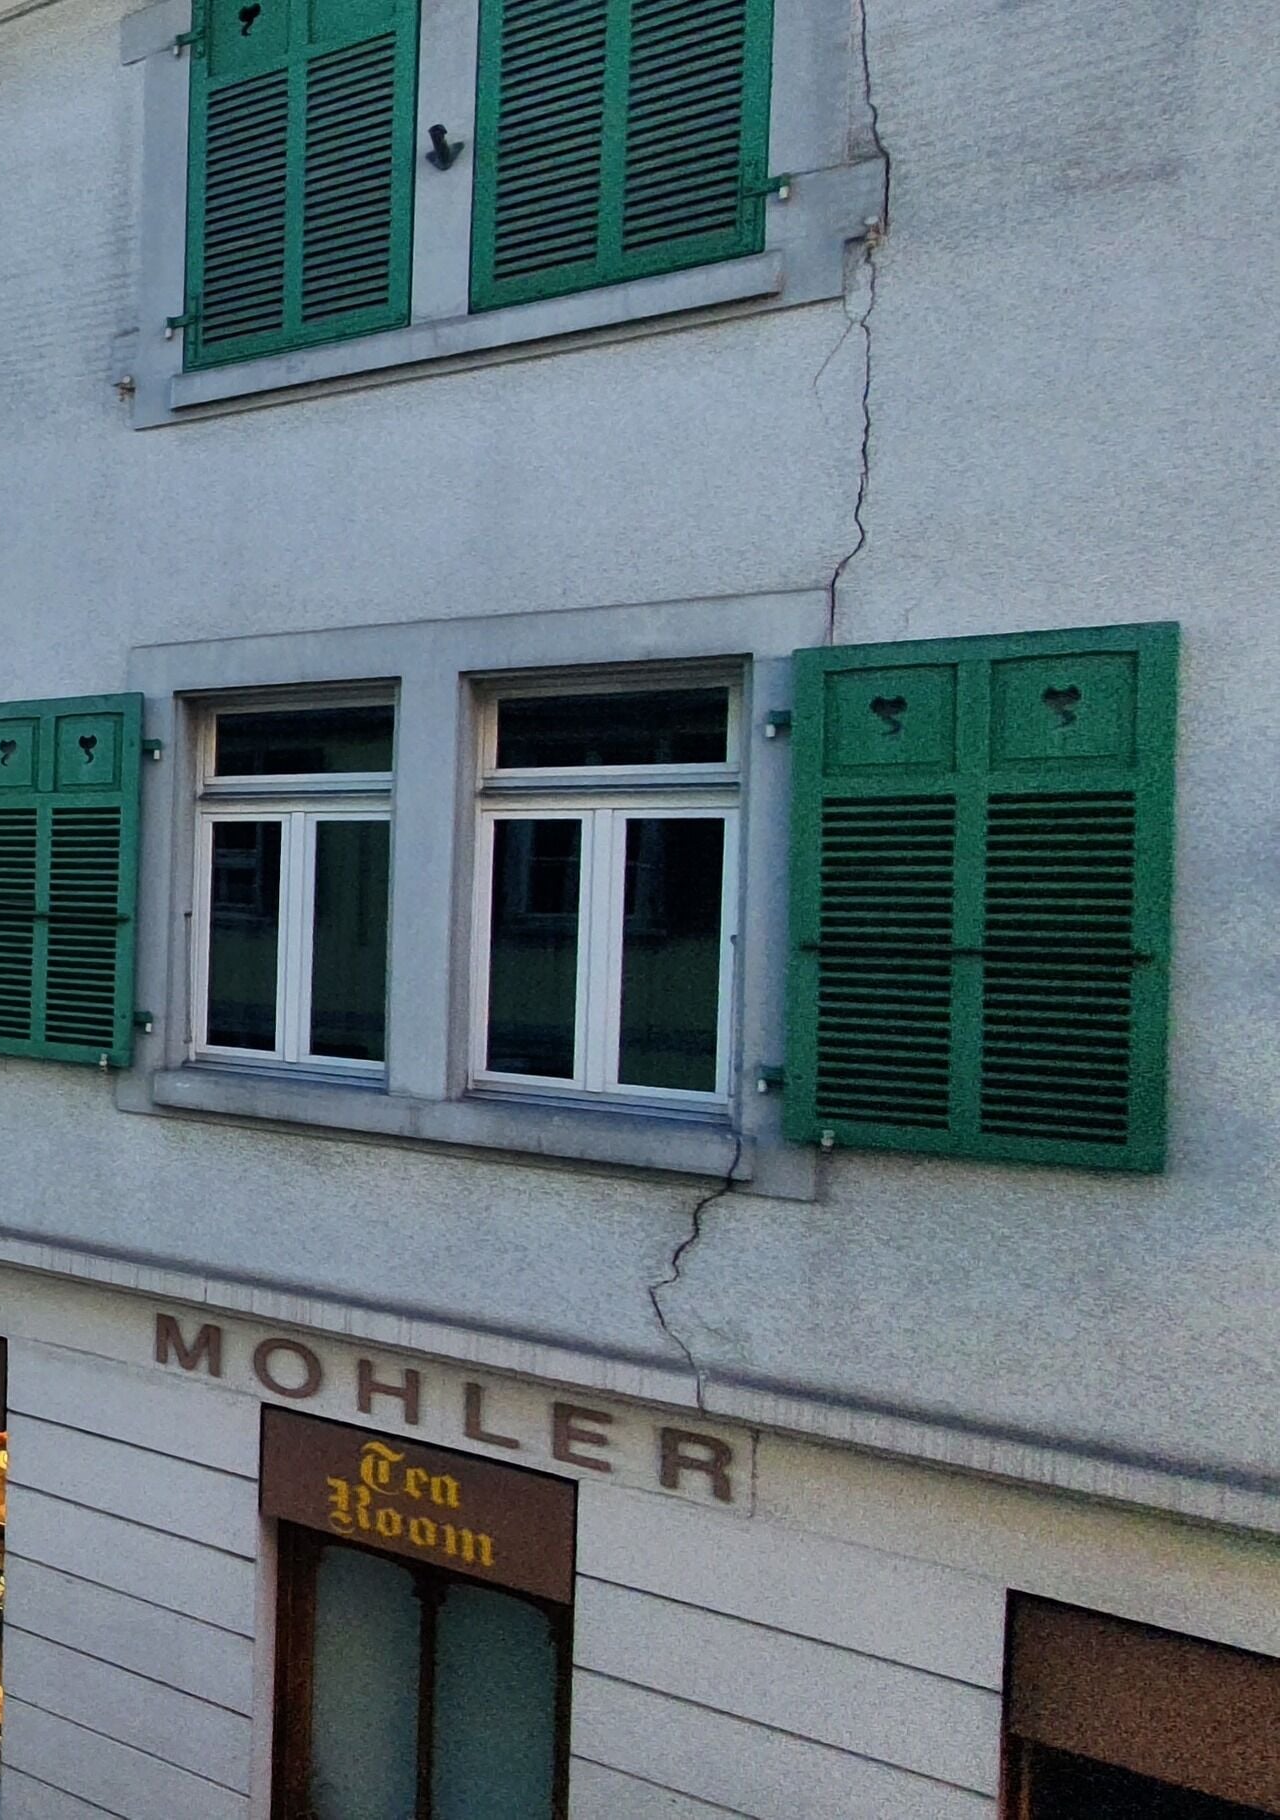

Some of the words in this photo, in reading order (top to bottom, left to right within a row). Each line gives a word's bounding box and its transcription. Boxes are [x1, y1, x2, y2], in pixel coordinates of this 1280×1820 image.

[155, 1312, 733, 1501] MOHLER
[361, 1441, 460, 1508] Tea
[327, 1476, 494, 1567] Room
